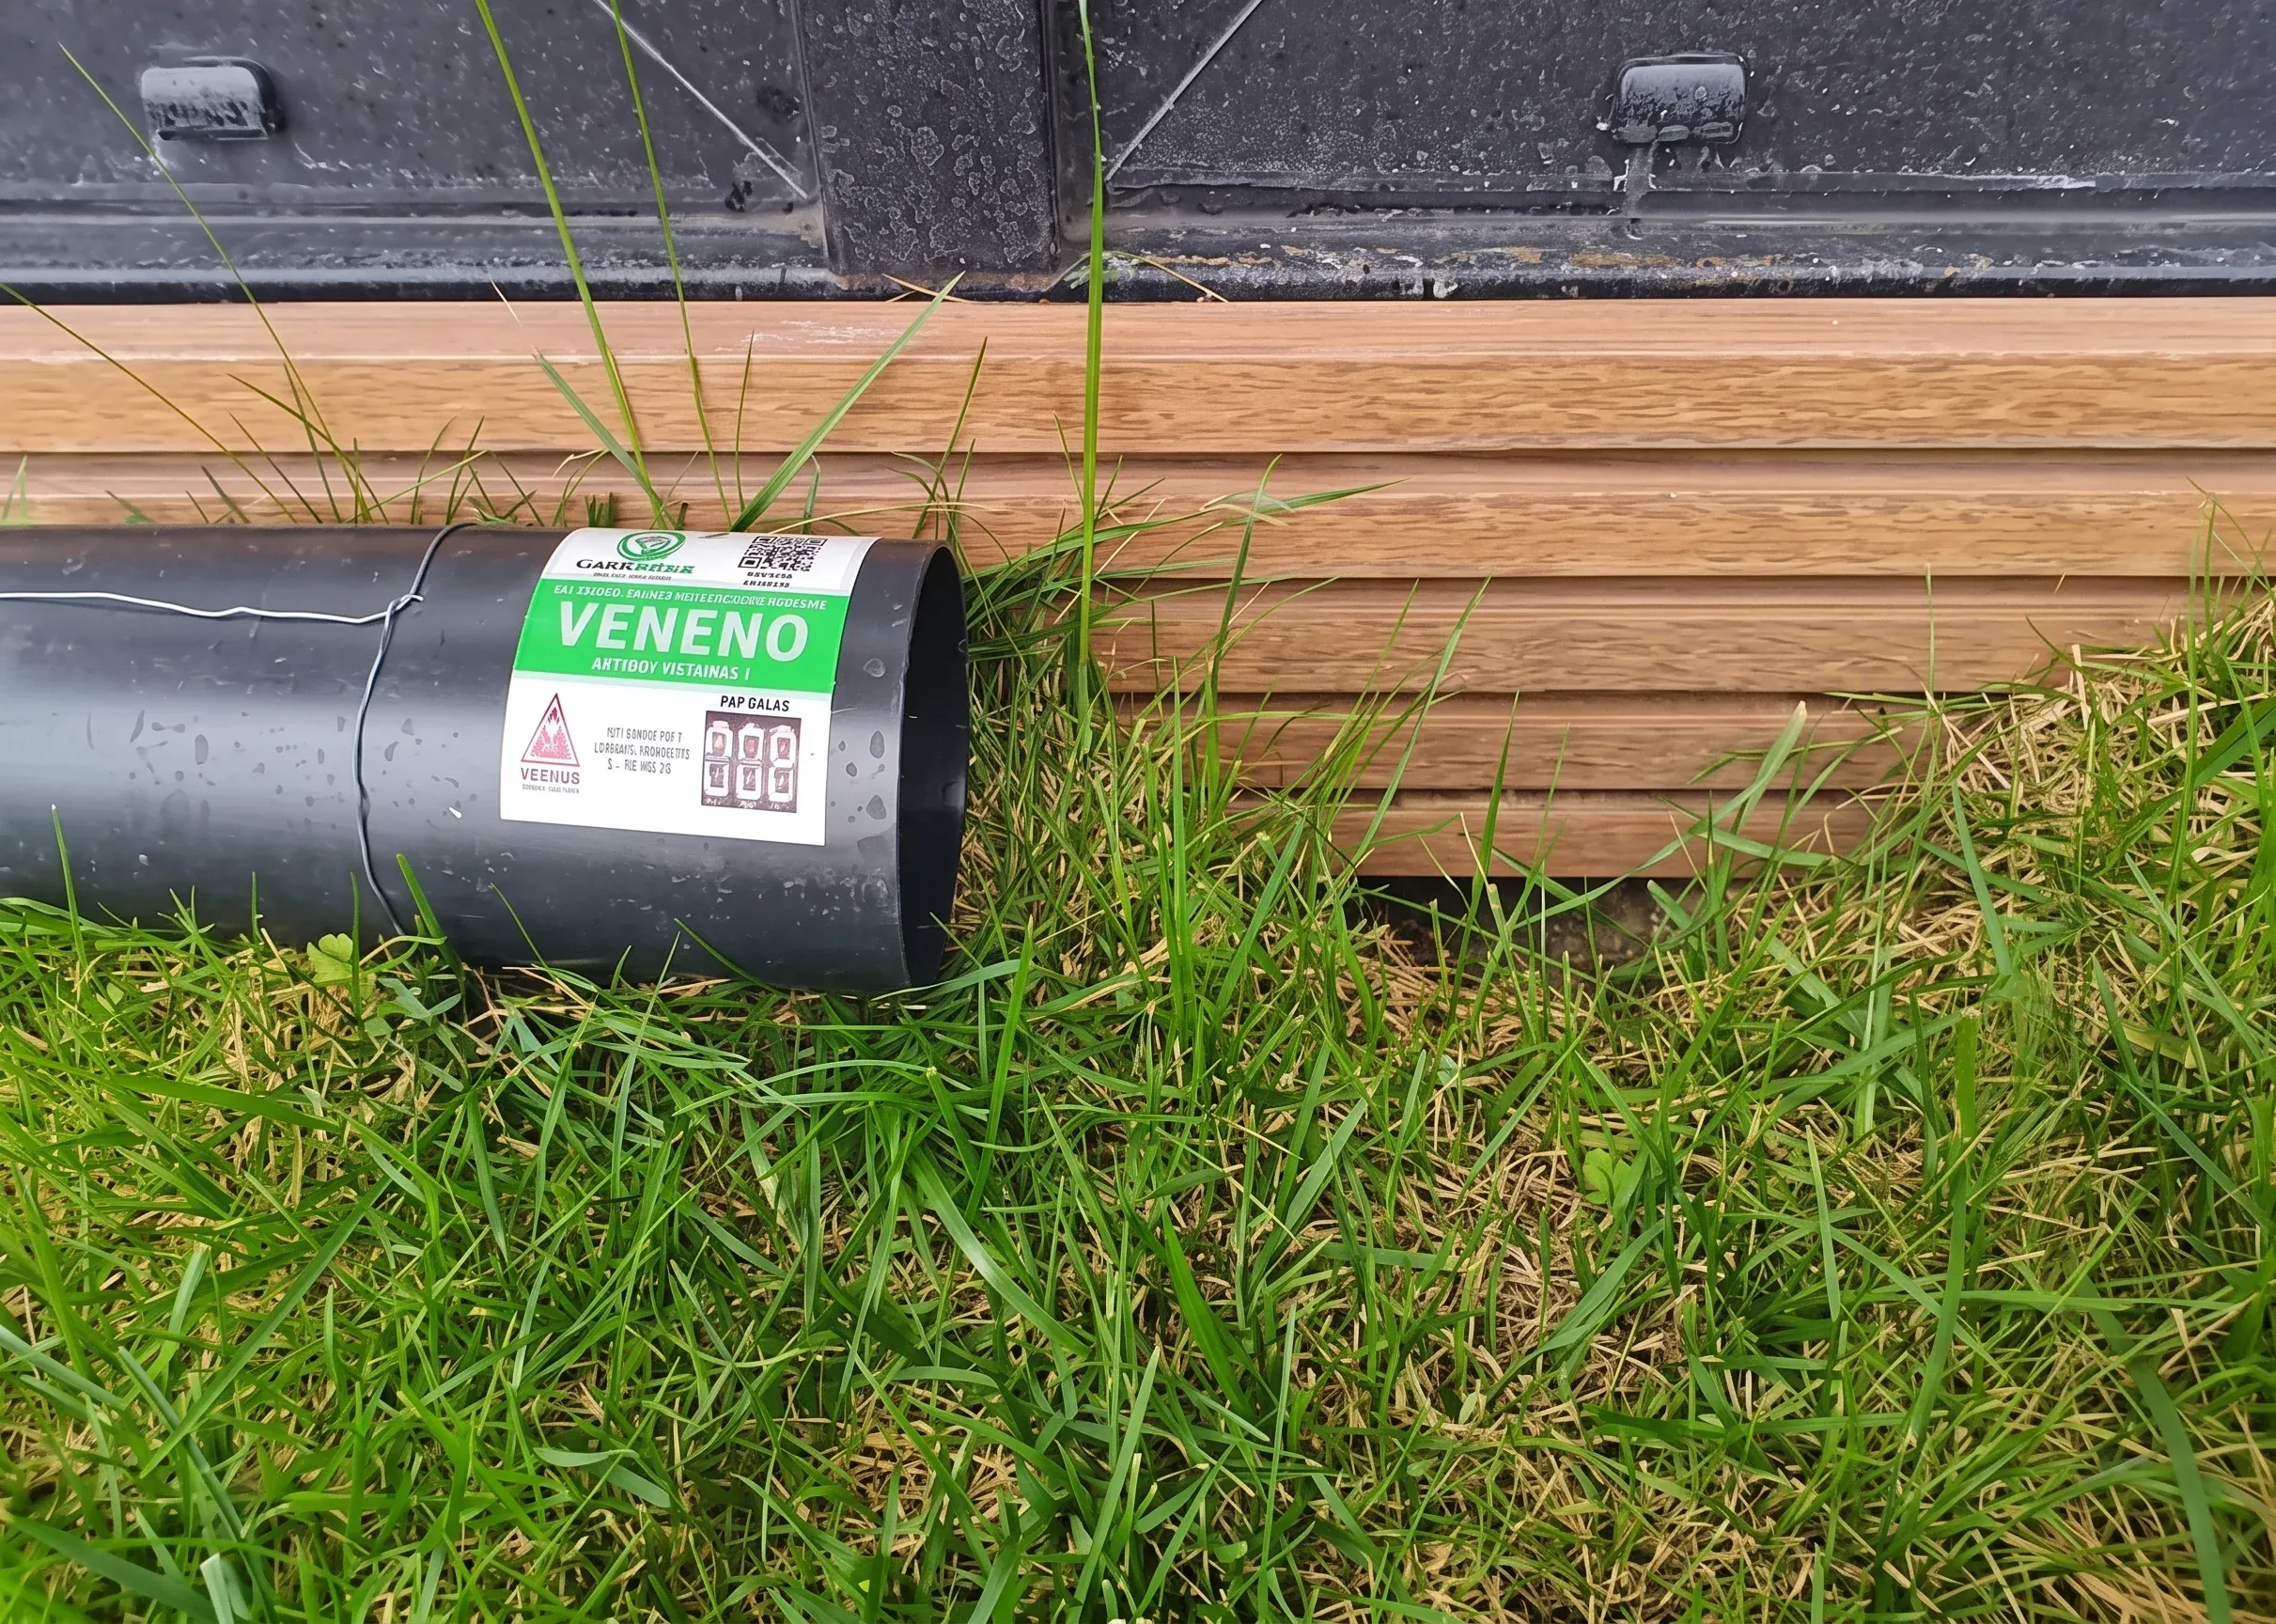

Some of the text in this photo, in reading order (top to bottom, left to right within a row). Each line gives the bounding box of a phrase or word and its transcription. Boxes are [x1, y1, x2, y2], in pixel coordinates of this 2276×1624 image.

[560, 601, 809, 663] VENENO
[720, 695, 790, 711] PAP GALAS
[521, 767, 580, 785] VEENUS
